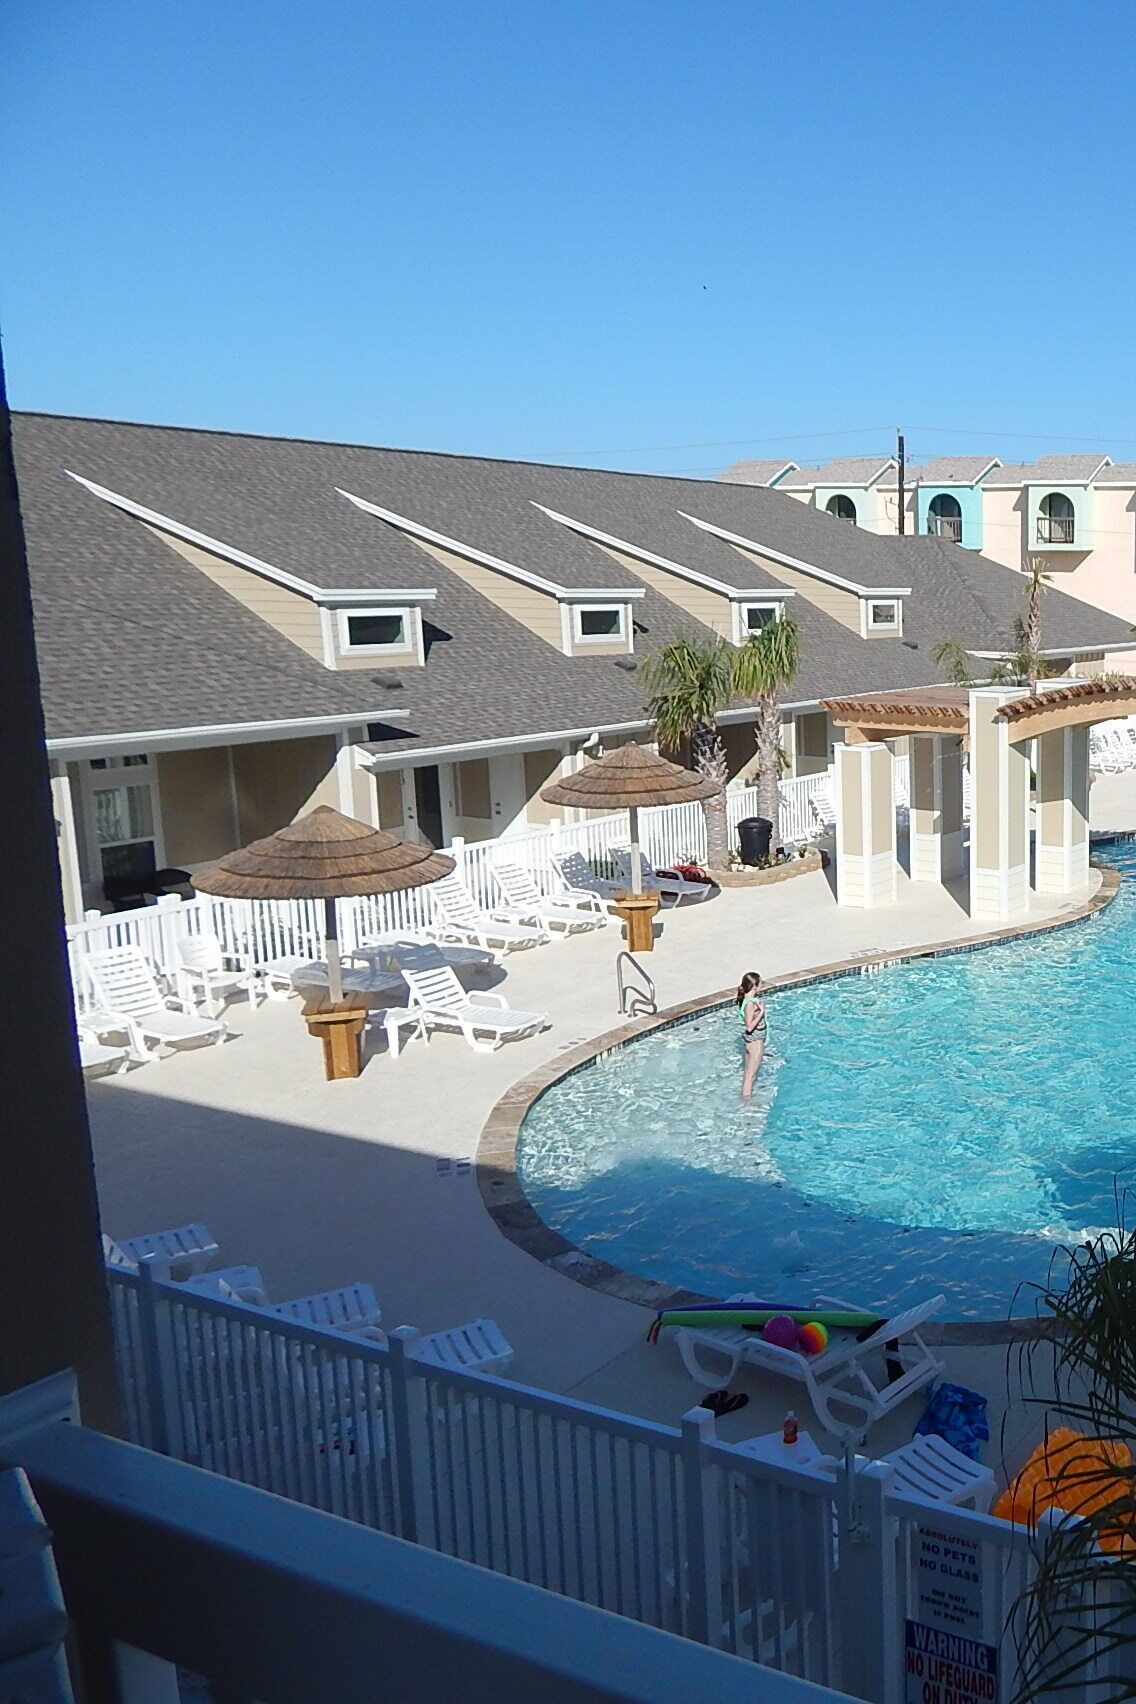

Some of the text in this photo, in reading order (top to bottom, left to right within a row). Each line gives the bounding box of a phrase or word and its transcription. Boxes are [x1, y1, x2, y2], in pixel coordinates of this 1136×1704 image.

[919, 1527, 978, 1550] ABSOLUTELY
[921, 1541, 976, 1565] NO PETS
[919, 1557, 979, 1583] NO GLASS
[913, 1624, 988, 1670] WARNING
[907, 1650, 995, 1701] NO LIFEGUARD
[922, 1681, 940, 1704] ON
